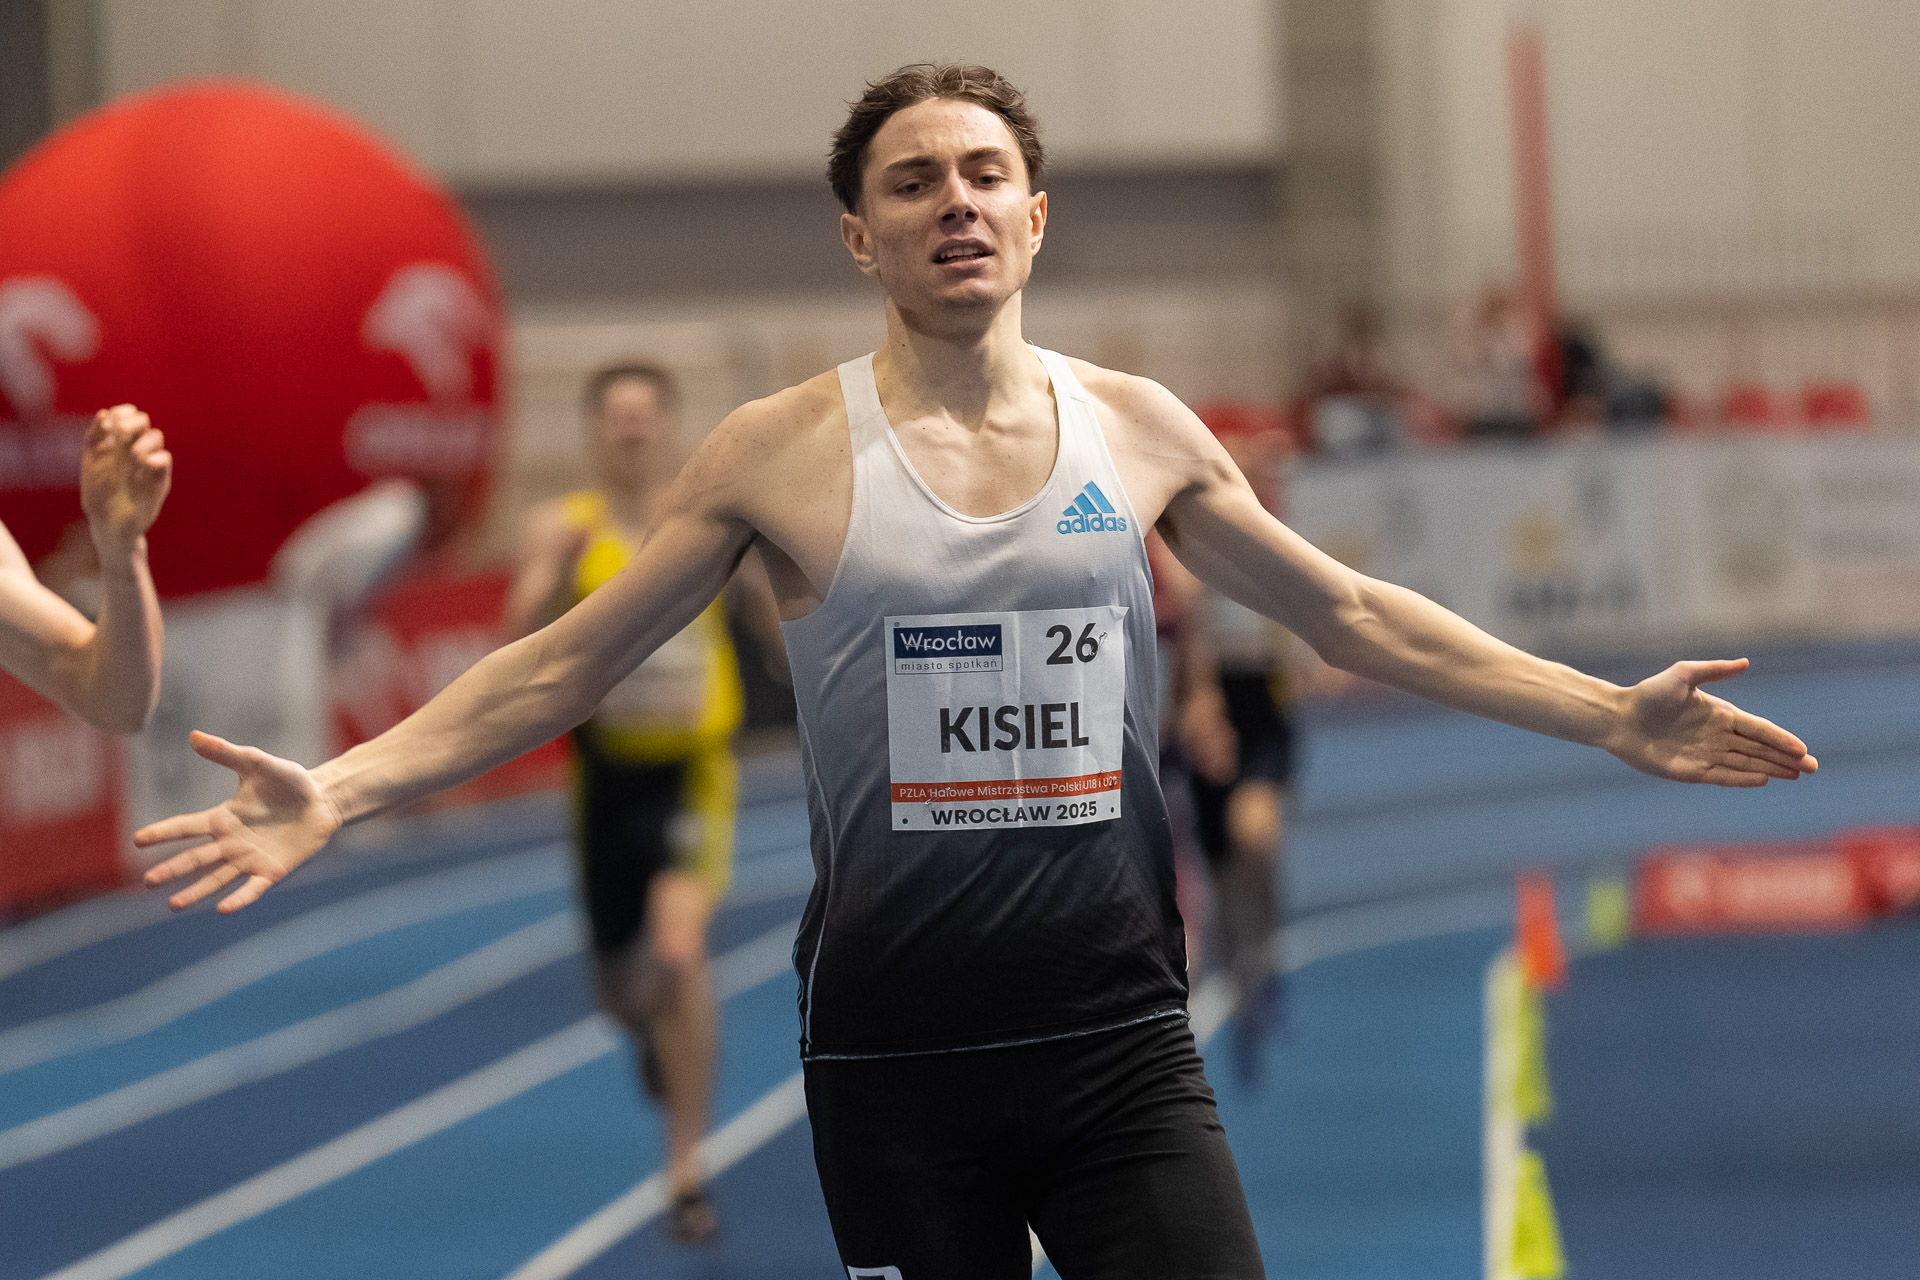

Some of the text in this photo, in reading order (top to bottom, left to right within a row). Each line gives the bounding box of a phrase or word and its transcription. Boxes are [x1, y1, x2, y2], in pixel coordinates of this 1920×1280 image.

[1056, 512, 1127, 534] adidas
[900, 630, 996, 652] Wrocław
[1046, 623, 1098, 665] 26
[901, 662, 943, 671] miasto
[948, 658, 998, 671] spotkań
[940, 702, 1089, 753] KISIEL
[899, 788, 927, 798] PZLA
[977, 785, 1048, 796] Mistrzostwa
[1051, 782, 1082, 793] Polski
[1083, 778, 1097, 790] U18
[931, 800, 1097, 825] WROCŁAW 2025
